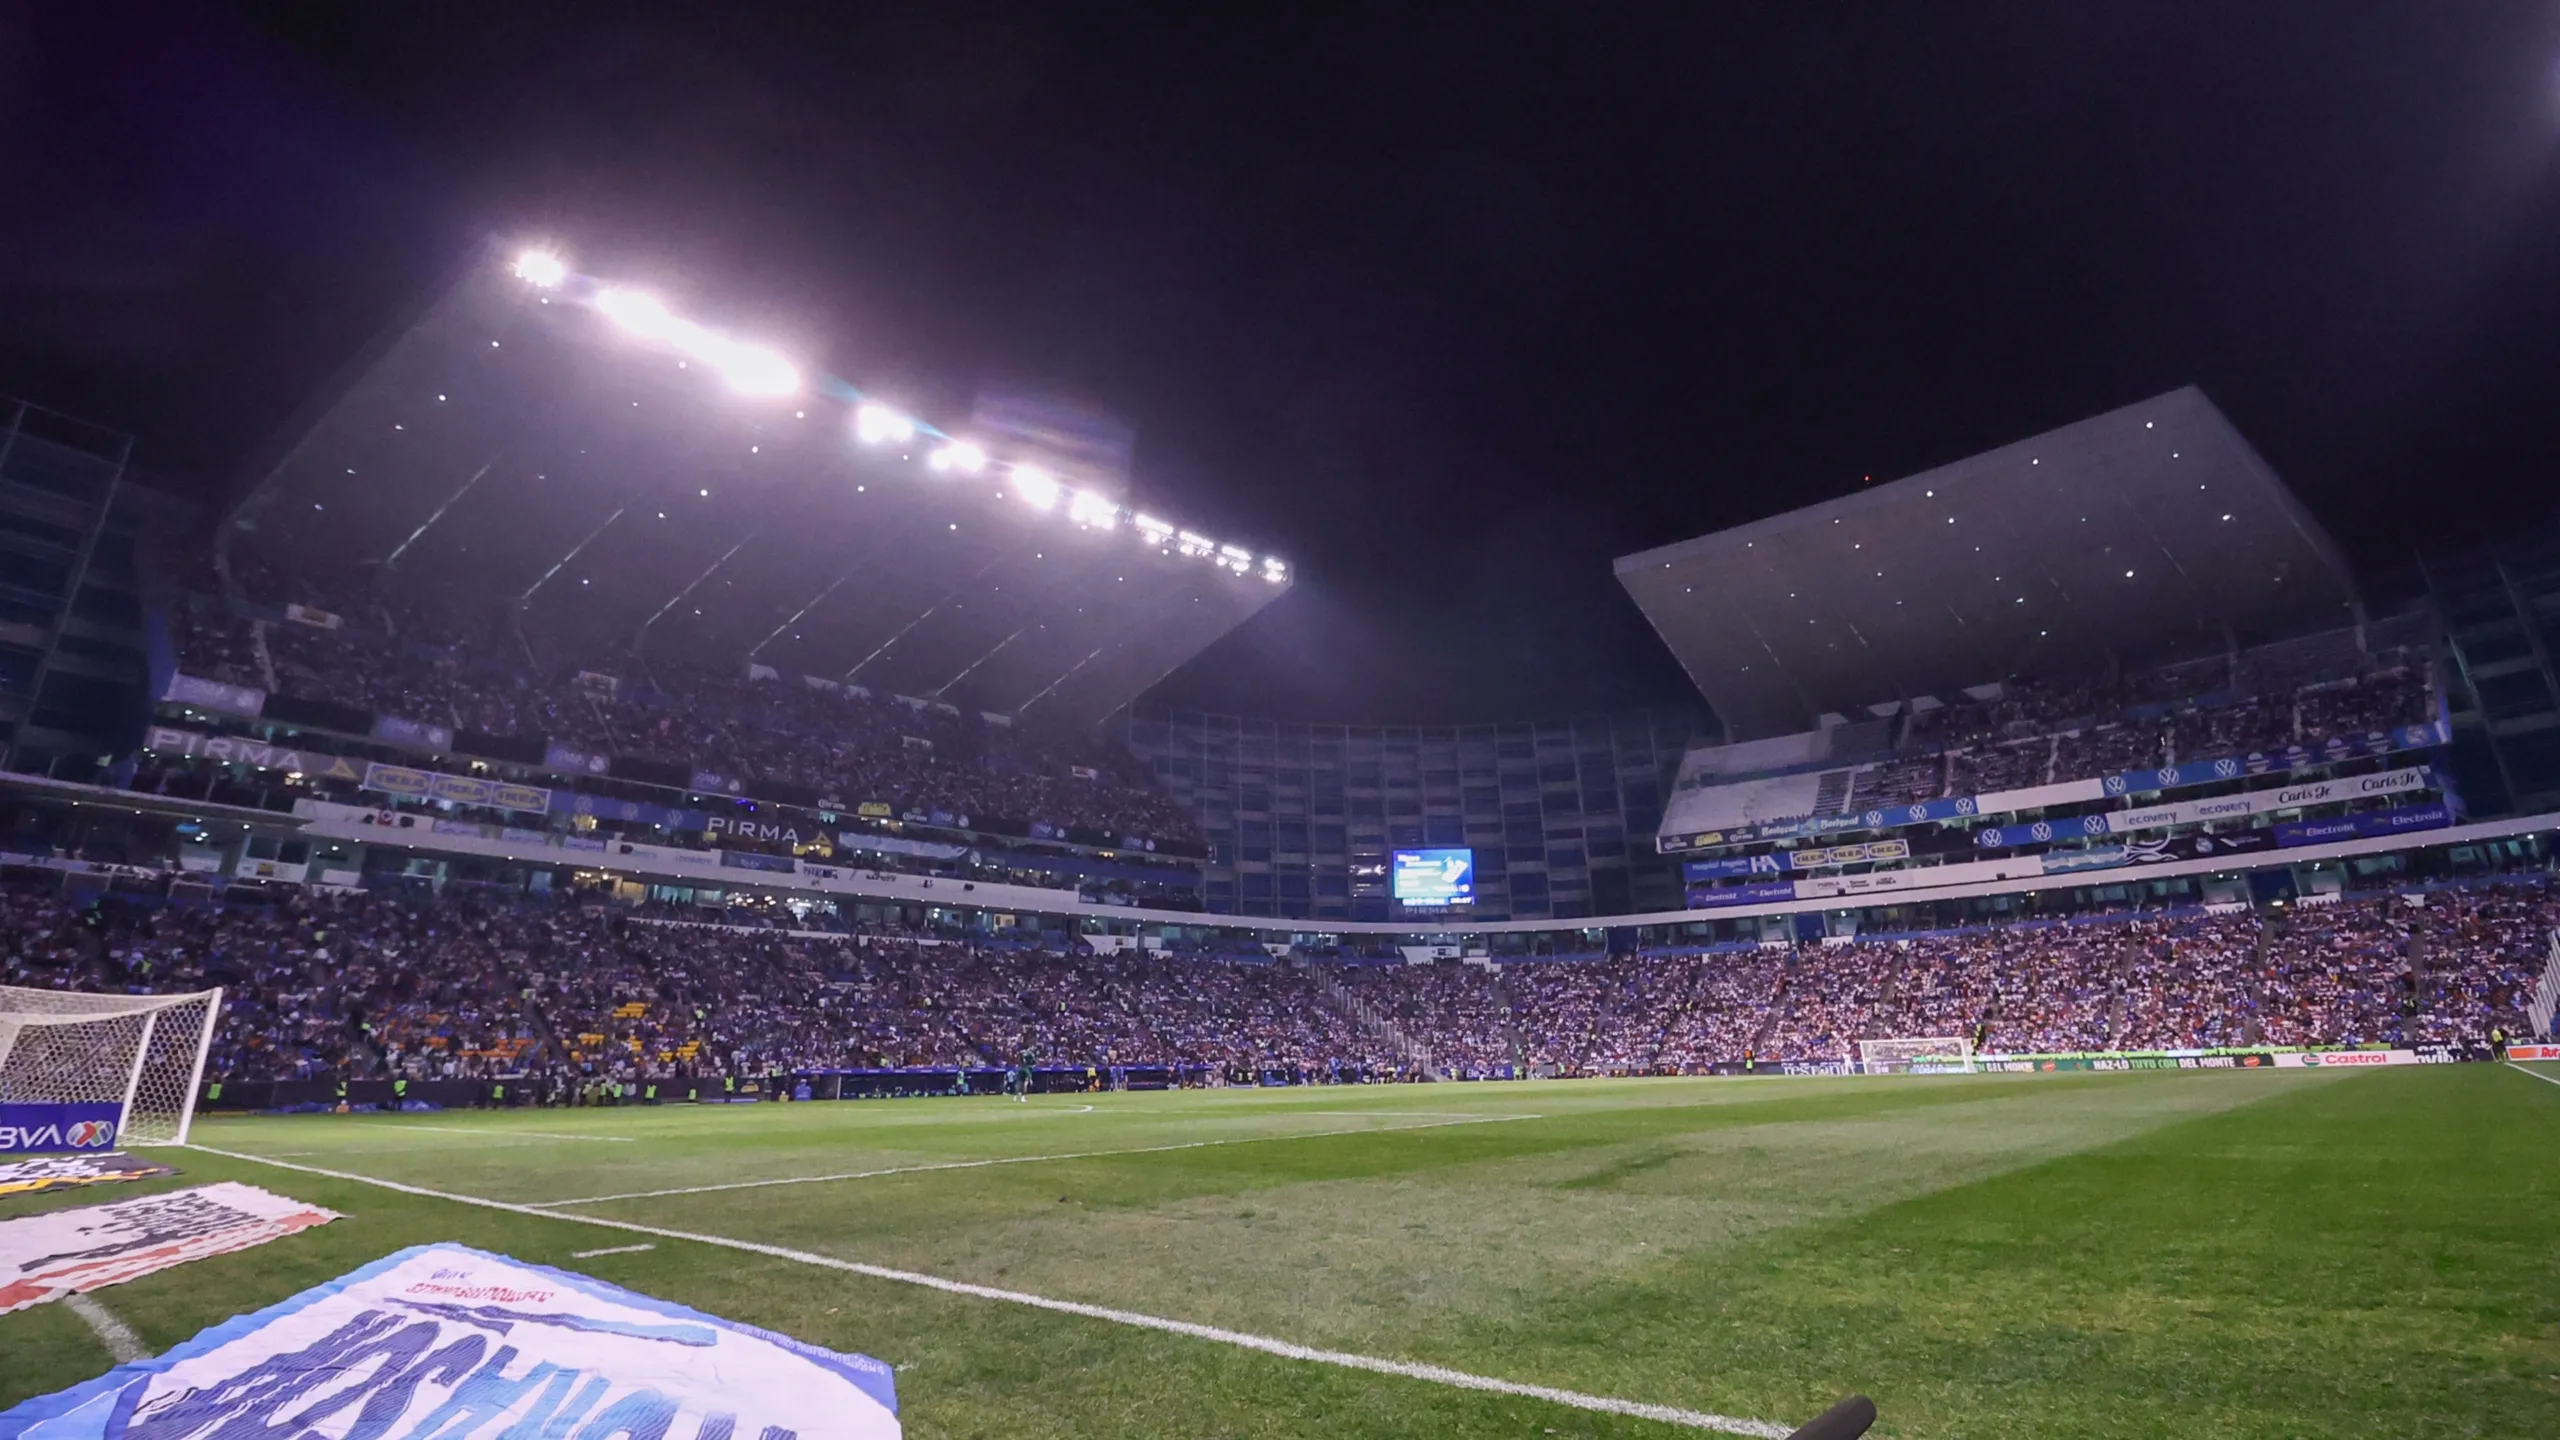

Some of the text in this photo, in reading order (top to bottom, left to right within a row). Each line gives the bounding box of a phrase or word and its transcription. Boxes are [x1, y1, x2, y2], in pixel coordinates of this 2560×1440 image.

[151, 732, 300, 769] PIRMA
[708, 817, 800, 843] PIRMA
[1832, 849, 1864, 860] IKEA
[1870, 845, 1904, 855] IKEA
[1796, 853, 1826, 863] IKEA
[2179, 1058, 2197, 1068] DEL
[2199, 1056, 2236, 1068] MONTE
[2325, 1051, 2387, 1065] Castrol
